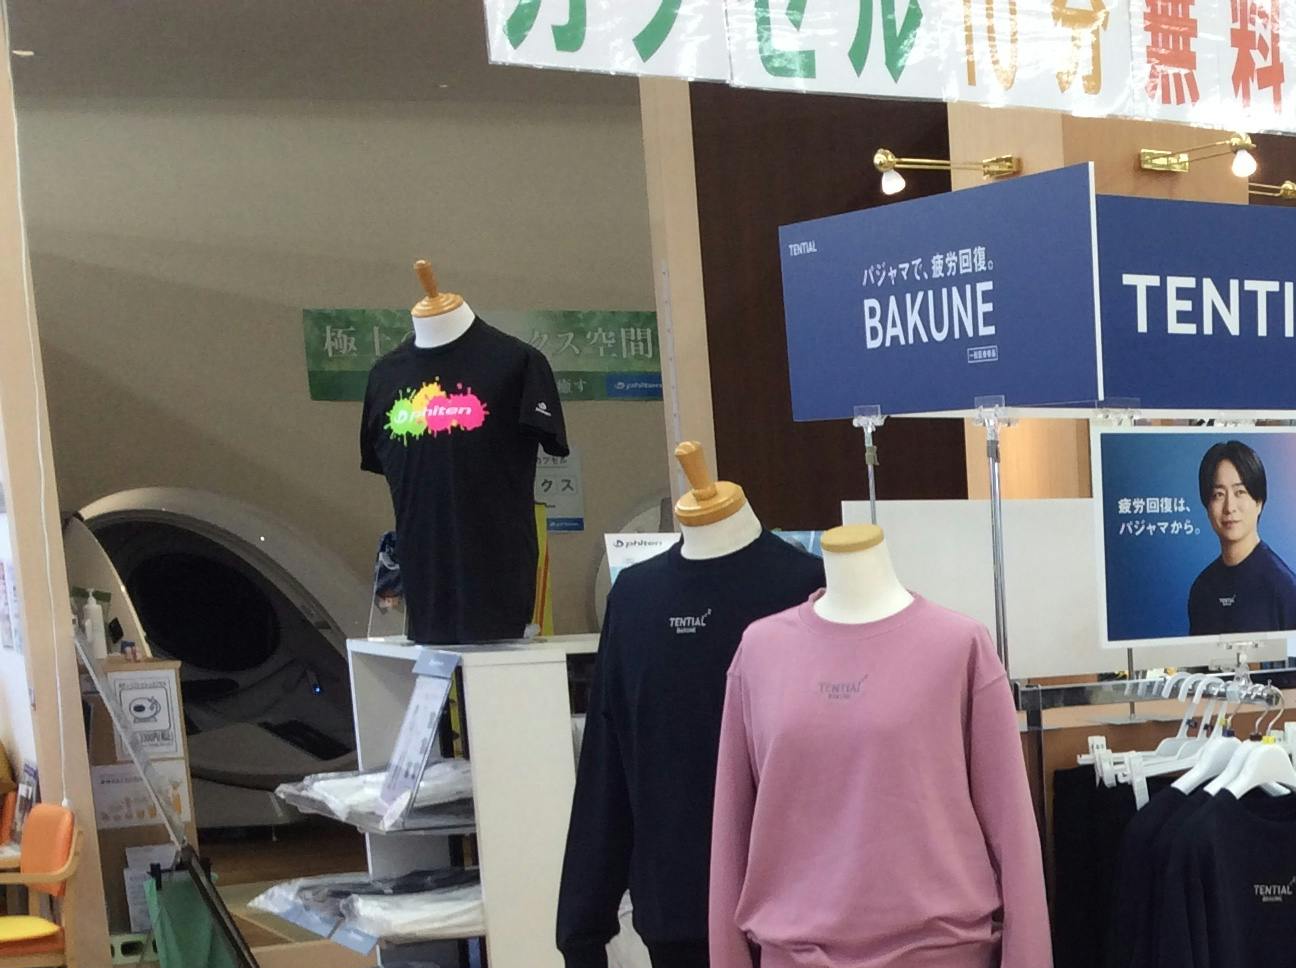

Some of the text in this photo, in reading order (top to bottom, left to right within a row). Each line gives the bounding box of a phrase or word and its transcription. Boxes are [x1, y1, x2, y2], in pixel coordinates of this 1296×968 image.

[788, 240, 817, 256] TENTIAL
[861, 246, 994, 288] パジャマで、疲労回復。
[863, 280, 996, 349] BAKUNE
[411, 405, 472, 422] phiten
[1118, 497, 1191, 516] 疲労回復は、
[1118, 517, 1201, 536] パジャマから。
[669, 616, 706, 627] TENTIAL
[1254, 885, 1293, 896] TENTIAL
